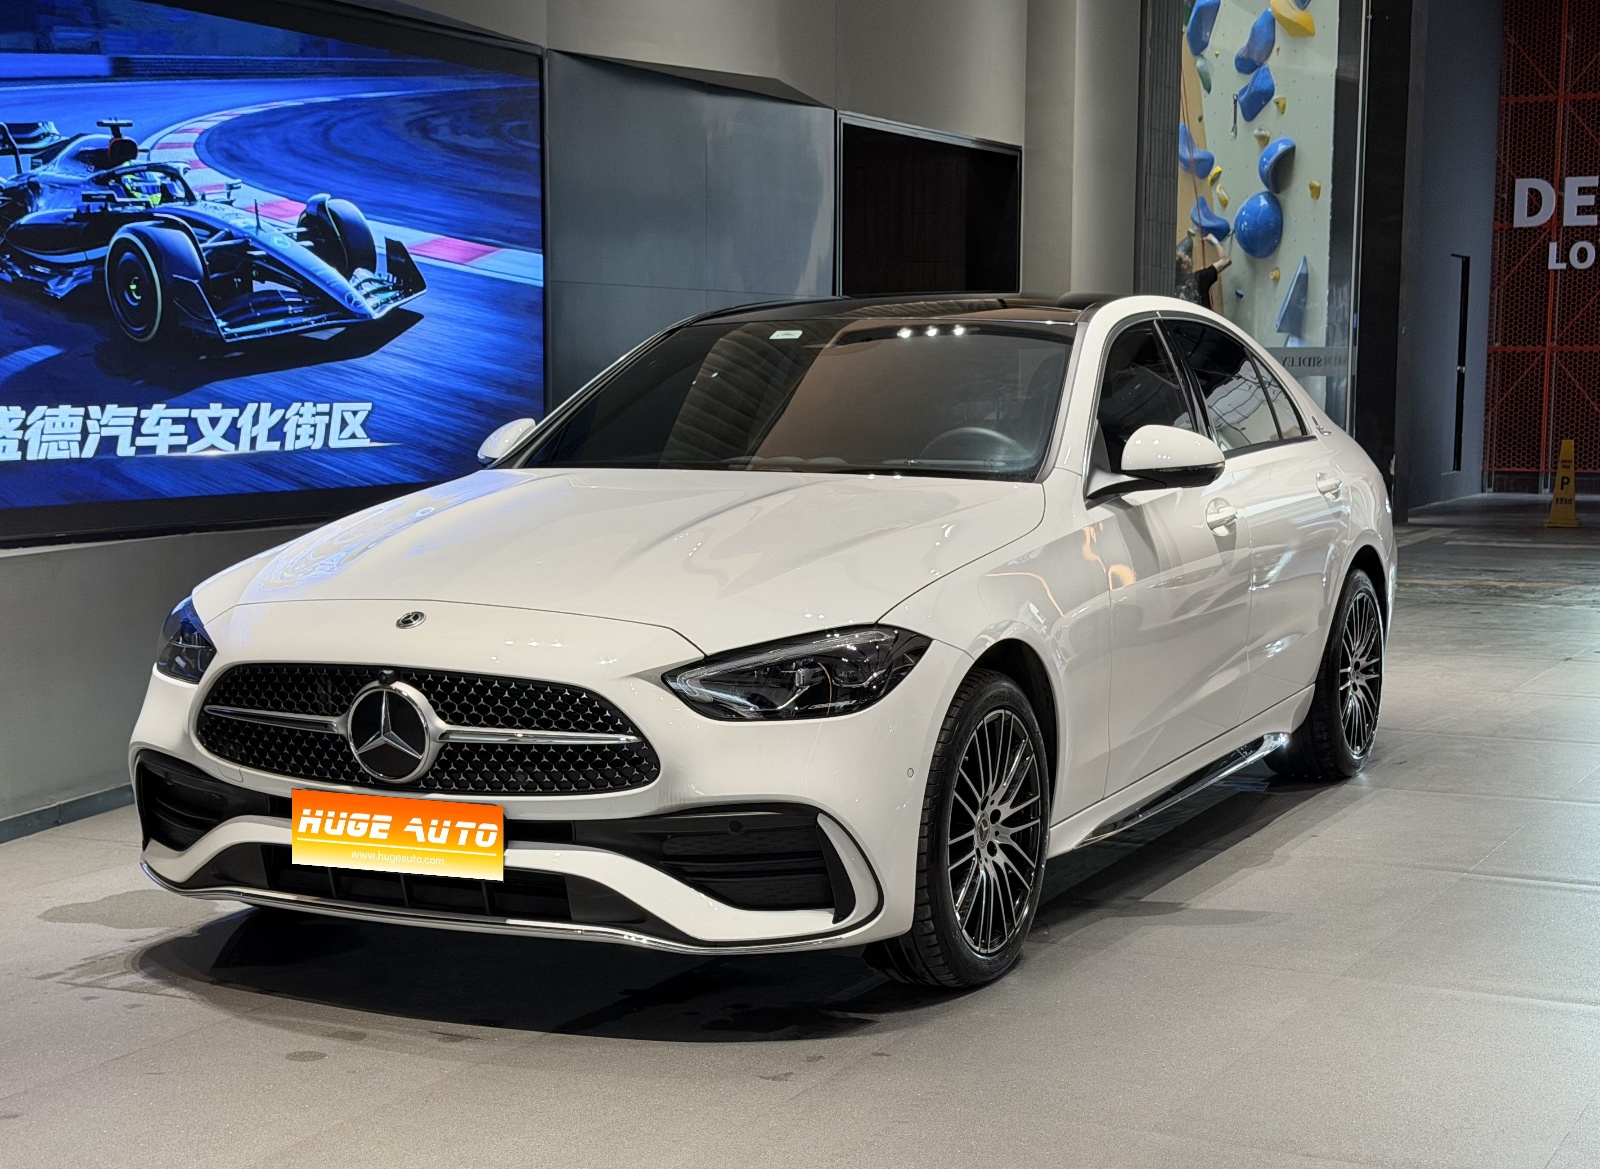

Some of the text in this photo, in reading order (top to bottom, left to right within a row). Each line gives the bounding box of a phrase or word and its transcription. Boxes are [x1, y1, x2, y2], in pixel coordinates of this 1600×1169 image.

[1513, 176, 1599, 228] DE
[1548, 240, 1596, 270] LO
[1560, 476, 1571, 491] P
